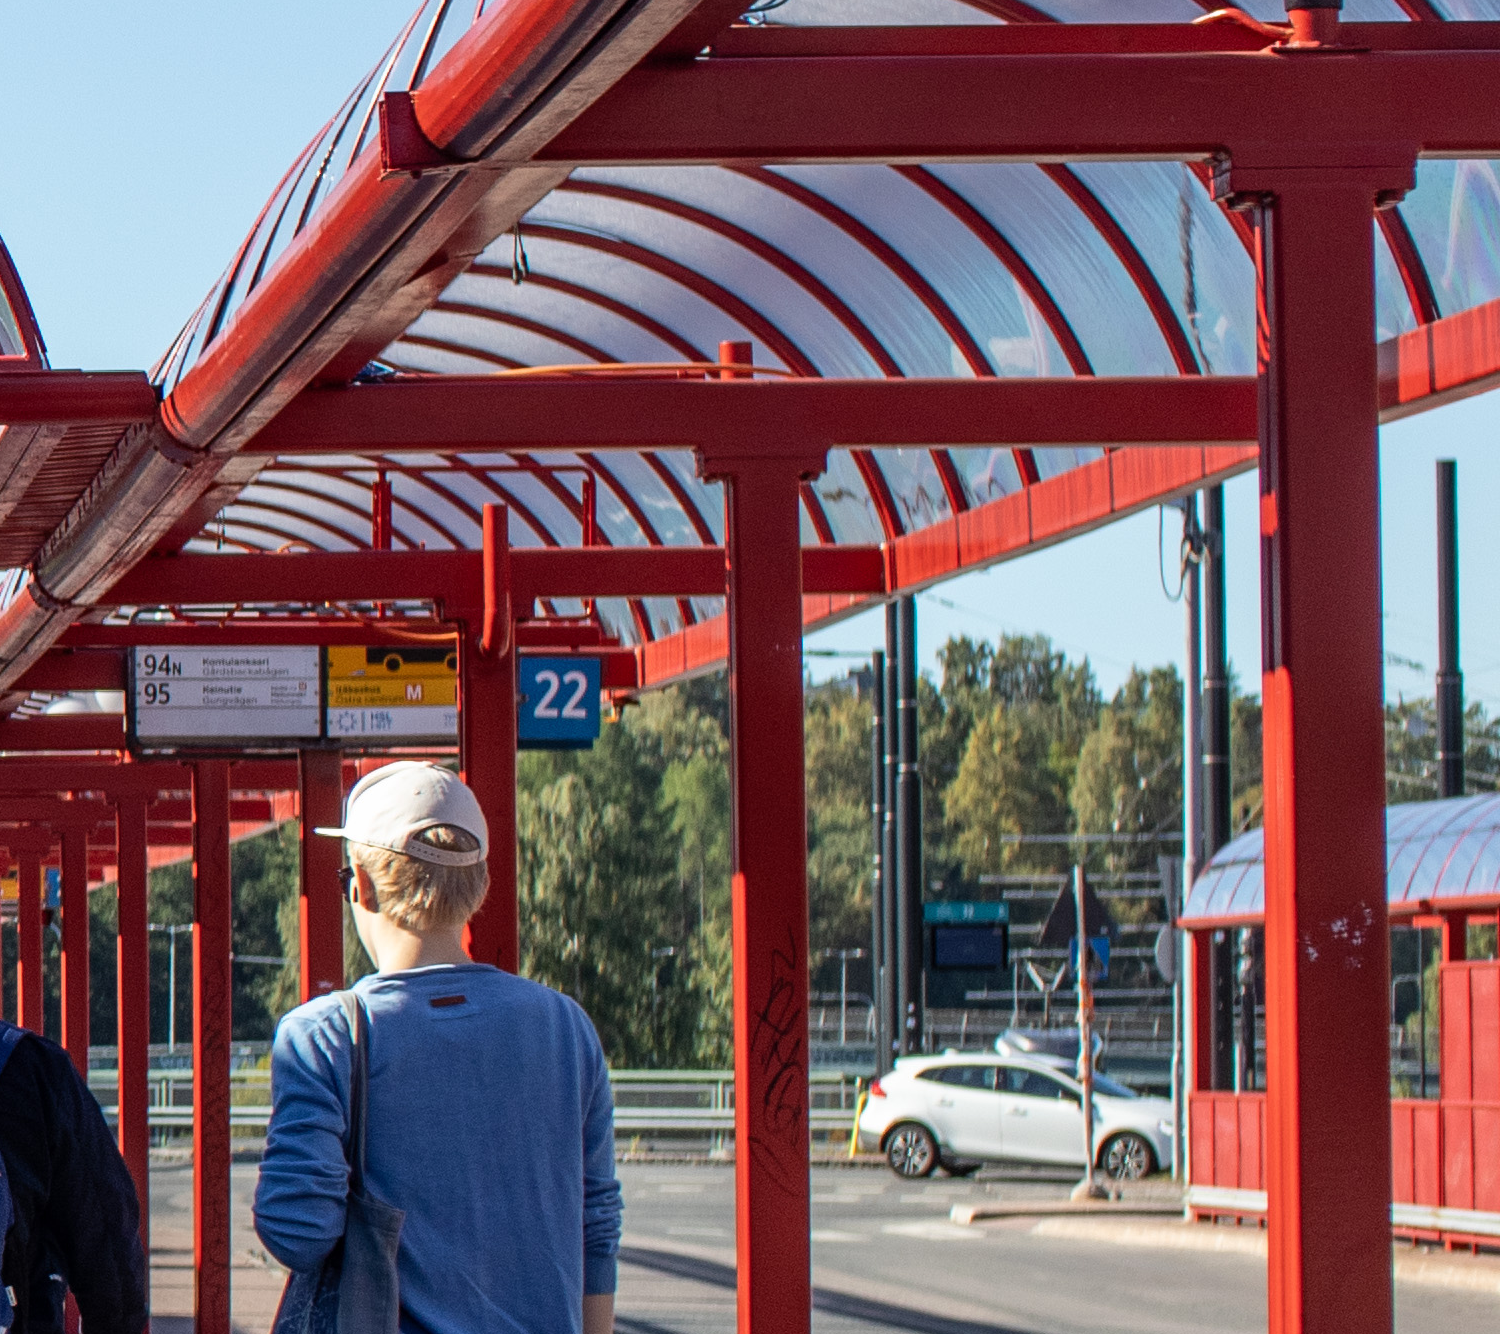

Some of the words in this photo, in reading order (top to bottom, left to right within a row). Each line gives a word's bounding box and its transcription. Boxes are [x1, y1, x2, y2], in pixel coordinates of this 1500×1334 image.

[143, 654, 182, 676] 94N
[144, 682, 170, 705] 95
[406, 684, 422, 700] M
[534, 670, 588, 720] 22
